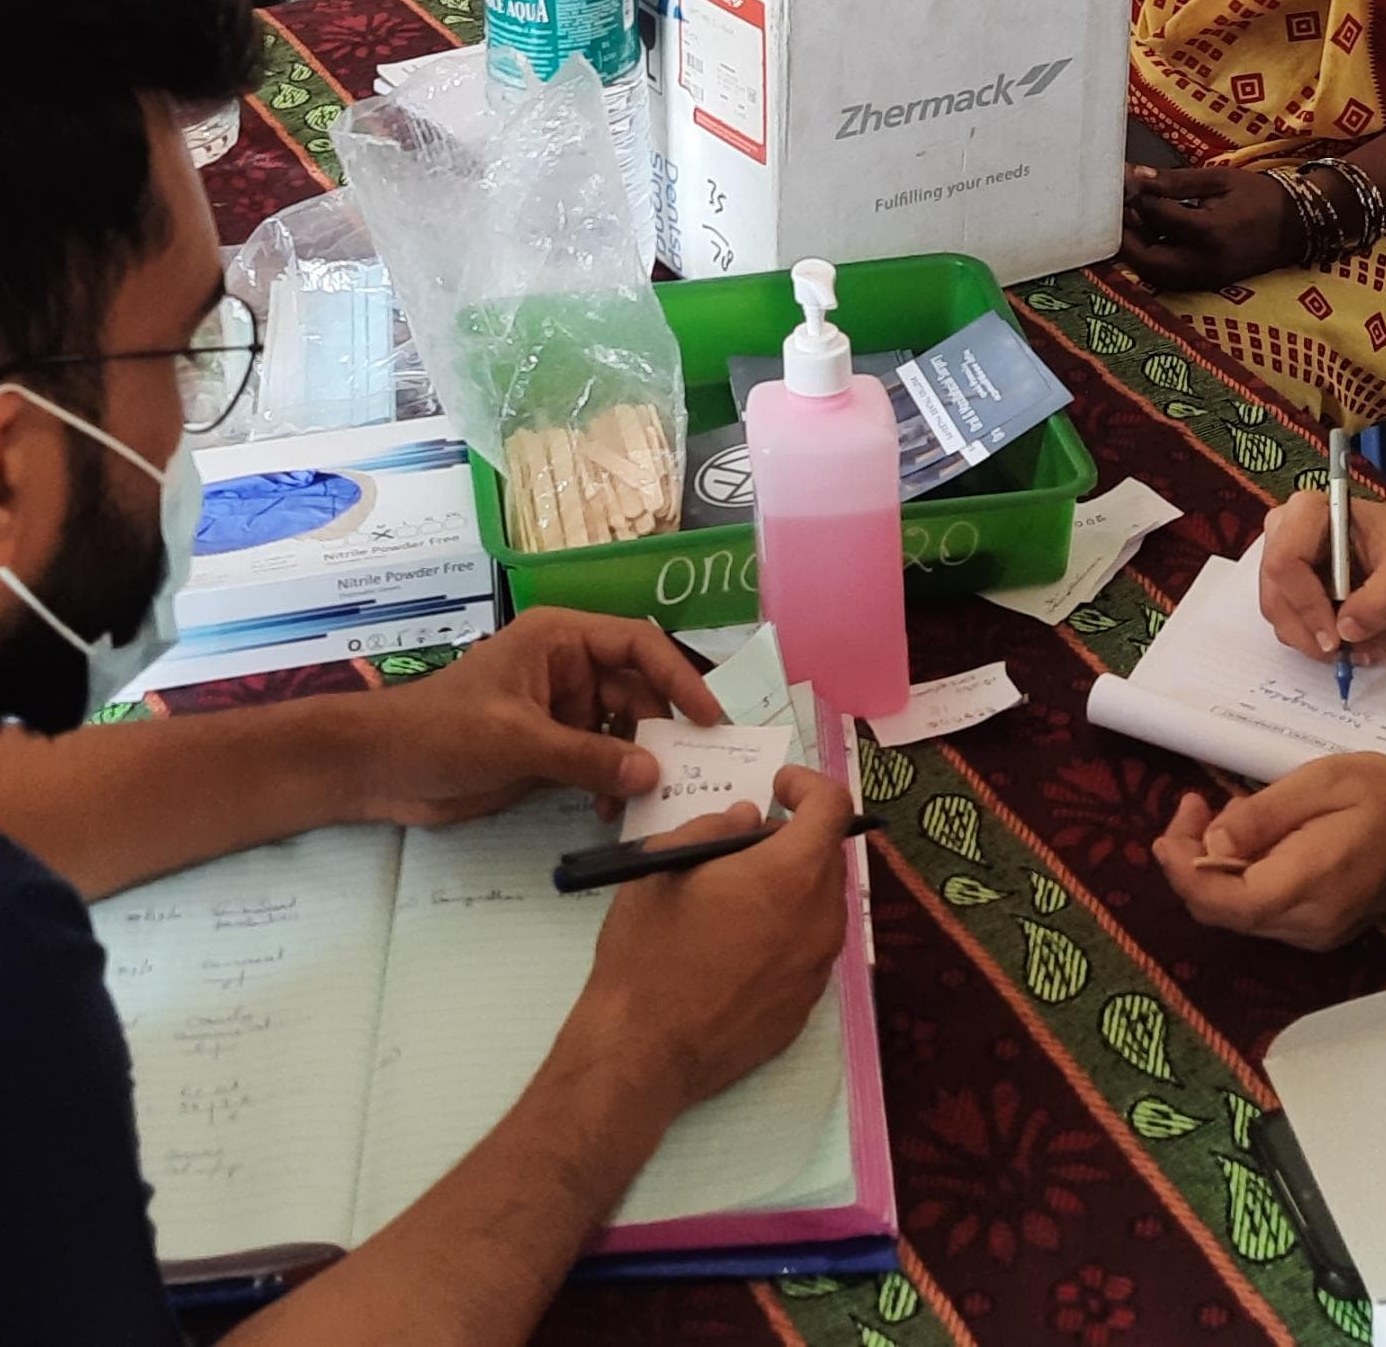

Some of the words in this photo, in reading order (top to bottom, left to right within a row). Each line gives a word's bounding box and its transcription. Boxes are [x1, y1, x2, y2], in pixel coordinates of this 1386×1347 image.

[835, 72, 1016, 140] Zhermack
[874, 186, 944, 213] Fulfilling
[946, 176, 983, 199] your
[985, 163, 1031, 186] needs
[323, 546, 368, 562] Nitrile
[371, 539, 426, 555] Powder
[428, 534, 461, 547] Free
[337, 574, 382, 591] Nitrile
[385, 565, 441, 583] Powder
[444, 560, 475, 575] Free
